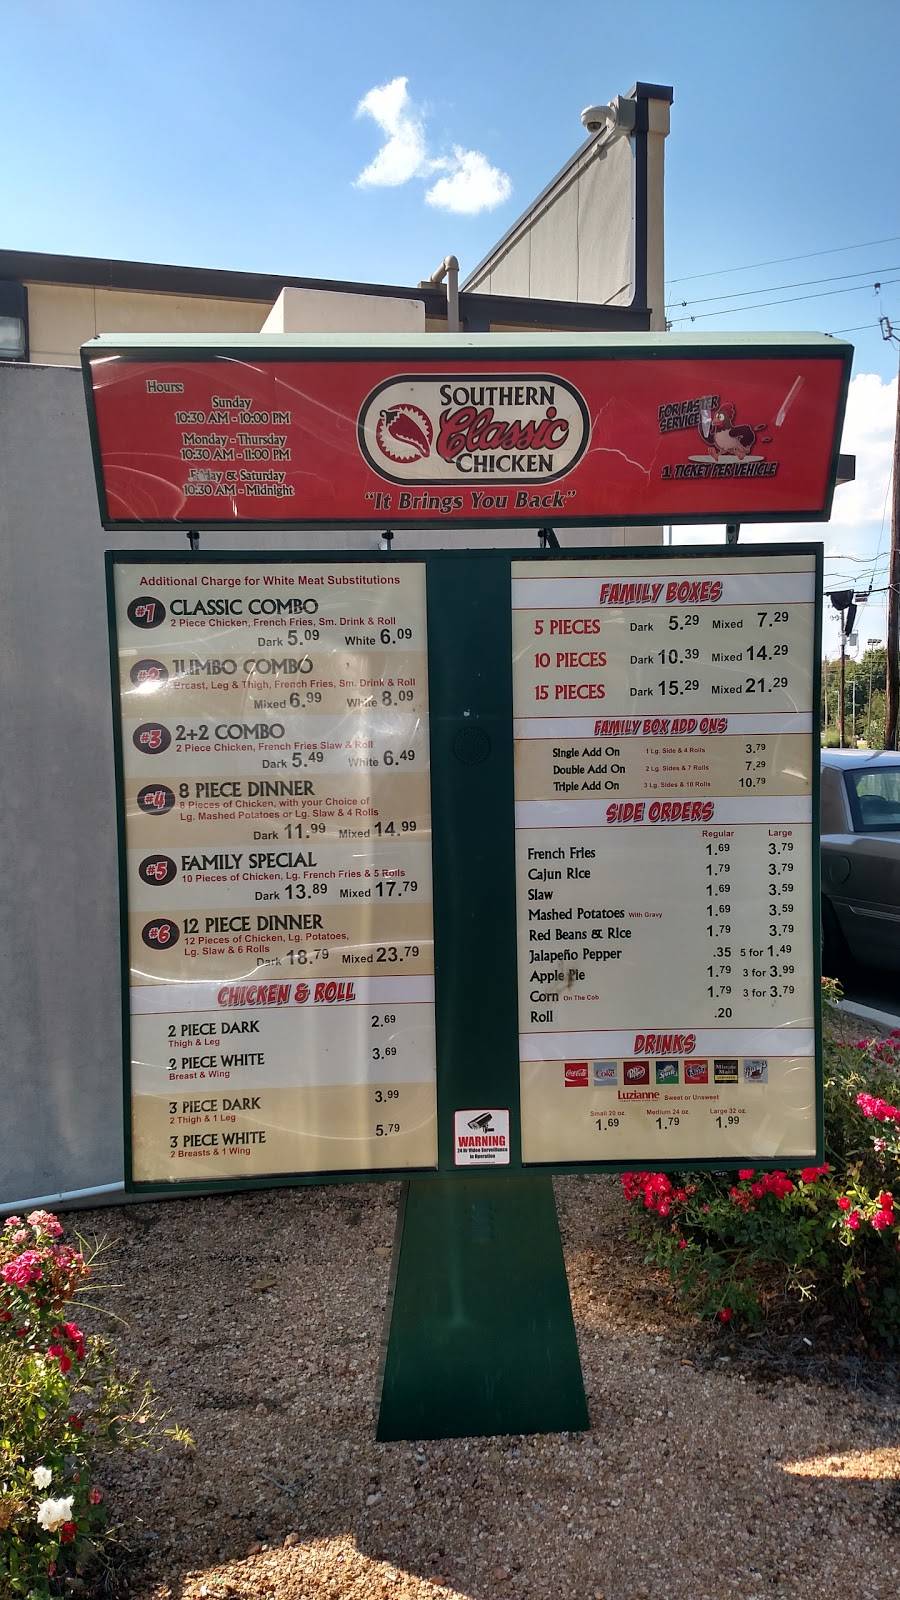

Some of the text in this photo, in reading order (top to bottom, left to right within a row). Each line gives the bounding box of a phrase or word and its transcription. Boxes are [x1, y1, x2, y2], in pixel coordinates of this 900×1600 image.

[147, 380, 184, 394] Hours:
[439, 385, 555, 406] SOUTHERN
[211, 397, 252, 410] Sunday
[659, 404, 680, 418] FOR
[175, 412, 291, 424] 10:30 AM 10:00 PM
[659, 413, 700, 432] SERVICE
[183, 433, 286, 447] Monday Thursday
[436, 406, 570, 463] Classic
[180, 448, 291, 461] 10:30 AM 11:00 PM
[455, 453, 554, 473] CHICKEN
[239, 469, 285, 482] Saturday
[662, 462, 778, 479] 1 TICKET PER VEHICLE
[182, 484, 294, 497] 10:30 AM Midnight
[398, 492, 464, 513] Brings
[469, 491, 509, 509] You
[140, 575, 400, 587] Additional Charge for White Meat Substitutions
[600, 581, 723, 604] FAMILY BOXES
[135, 599, 318, 623] #1 CLASSIC COMBO
[170, 617, 396, 627] 2 Piece Chicken, French Fries, Sm. Drink & Roll
[534, 612, 788, 634] 5 PIECES Dark 5.29 Mixed 7.29
[258, 629, 412, 647] Dark 5.09 White 6.09
[535, 645, 788, 668] 10 PIECES Dark 10.39 Mixed 14.29
[535, 678, 788, 700] 15 PIECES Dark 15.29 Mixed 21.29
[254, 699, 286, 710] Mixed
[289, 692, 322, 708] 6.99
[382, 691, 413, 706] 8.09
[594, 718, 727, 735] FAMILY BOX ADD ONS
[139, 724, 285, 748] #3 2+2 COMBO
[262, 750, 415, 769] Dark 5.49 White 6.49
[552, 744, 766, 758] Single Add On 3.79
[144, 781, 315, 809] #4 8 PIECE DINNER
[606, 802, 714, 822] SIDE ORDERS
[254, 821, 416, 840] Dark 11.99 Mixed 14.99
[702, 829, 792, 838] Regular Large
[528, 843, 793, 860] French Fries 1.69 3.79
[146, 852, 317, 880] #5 FAMILY SPECIAL
[528, 864, 793, 882] Cajun Rice 1.79 3.79
[255, 881, 418, 901] Dark 13.89 Mixed 17.79
[528, 884, 793, 900] Slaw 1.69 3.59
[149, 915, 323, 943] #6 12 PIECE DINNER
[530, 950, 578, 963] Jalapeño
[582, 948, 622, 962] Pepper
[740, 948, 746, 956] 5
[748, 948, 764, 957] for
[768, 945, 792, 956] 1.49
[217, 981, 355, 1006] CHICKEN & ROLL
[168, 1015, 396, 1037] 2 PIECE DARK 2.69
[634, 1034, 697, 1054] DRINKS
[208, 1070, 230, 1079] Wing
[618, 1090, 660, 1100] Luzianne
[596, 1116, 739, 1130] 1.69 1.79 1.99
[170, 1124, 400, 1148] 3 PIECE WHITE 5.79
[458, 1136, 505, 1147] WARNING
